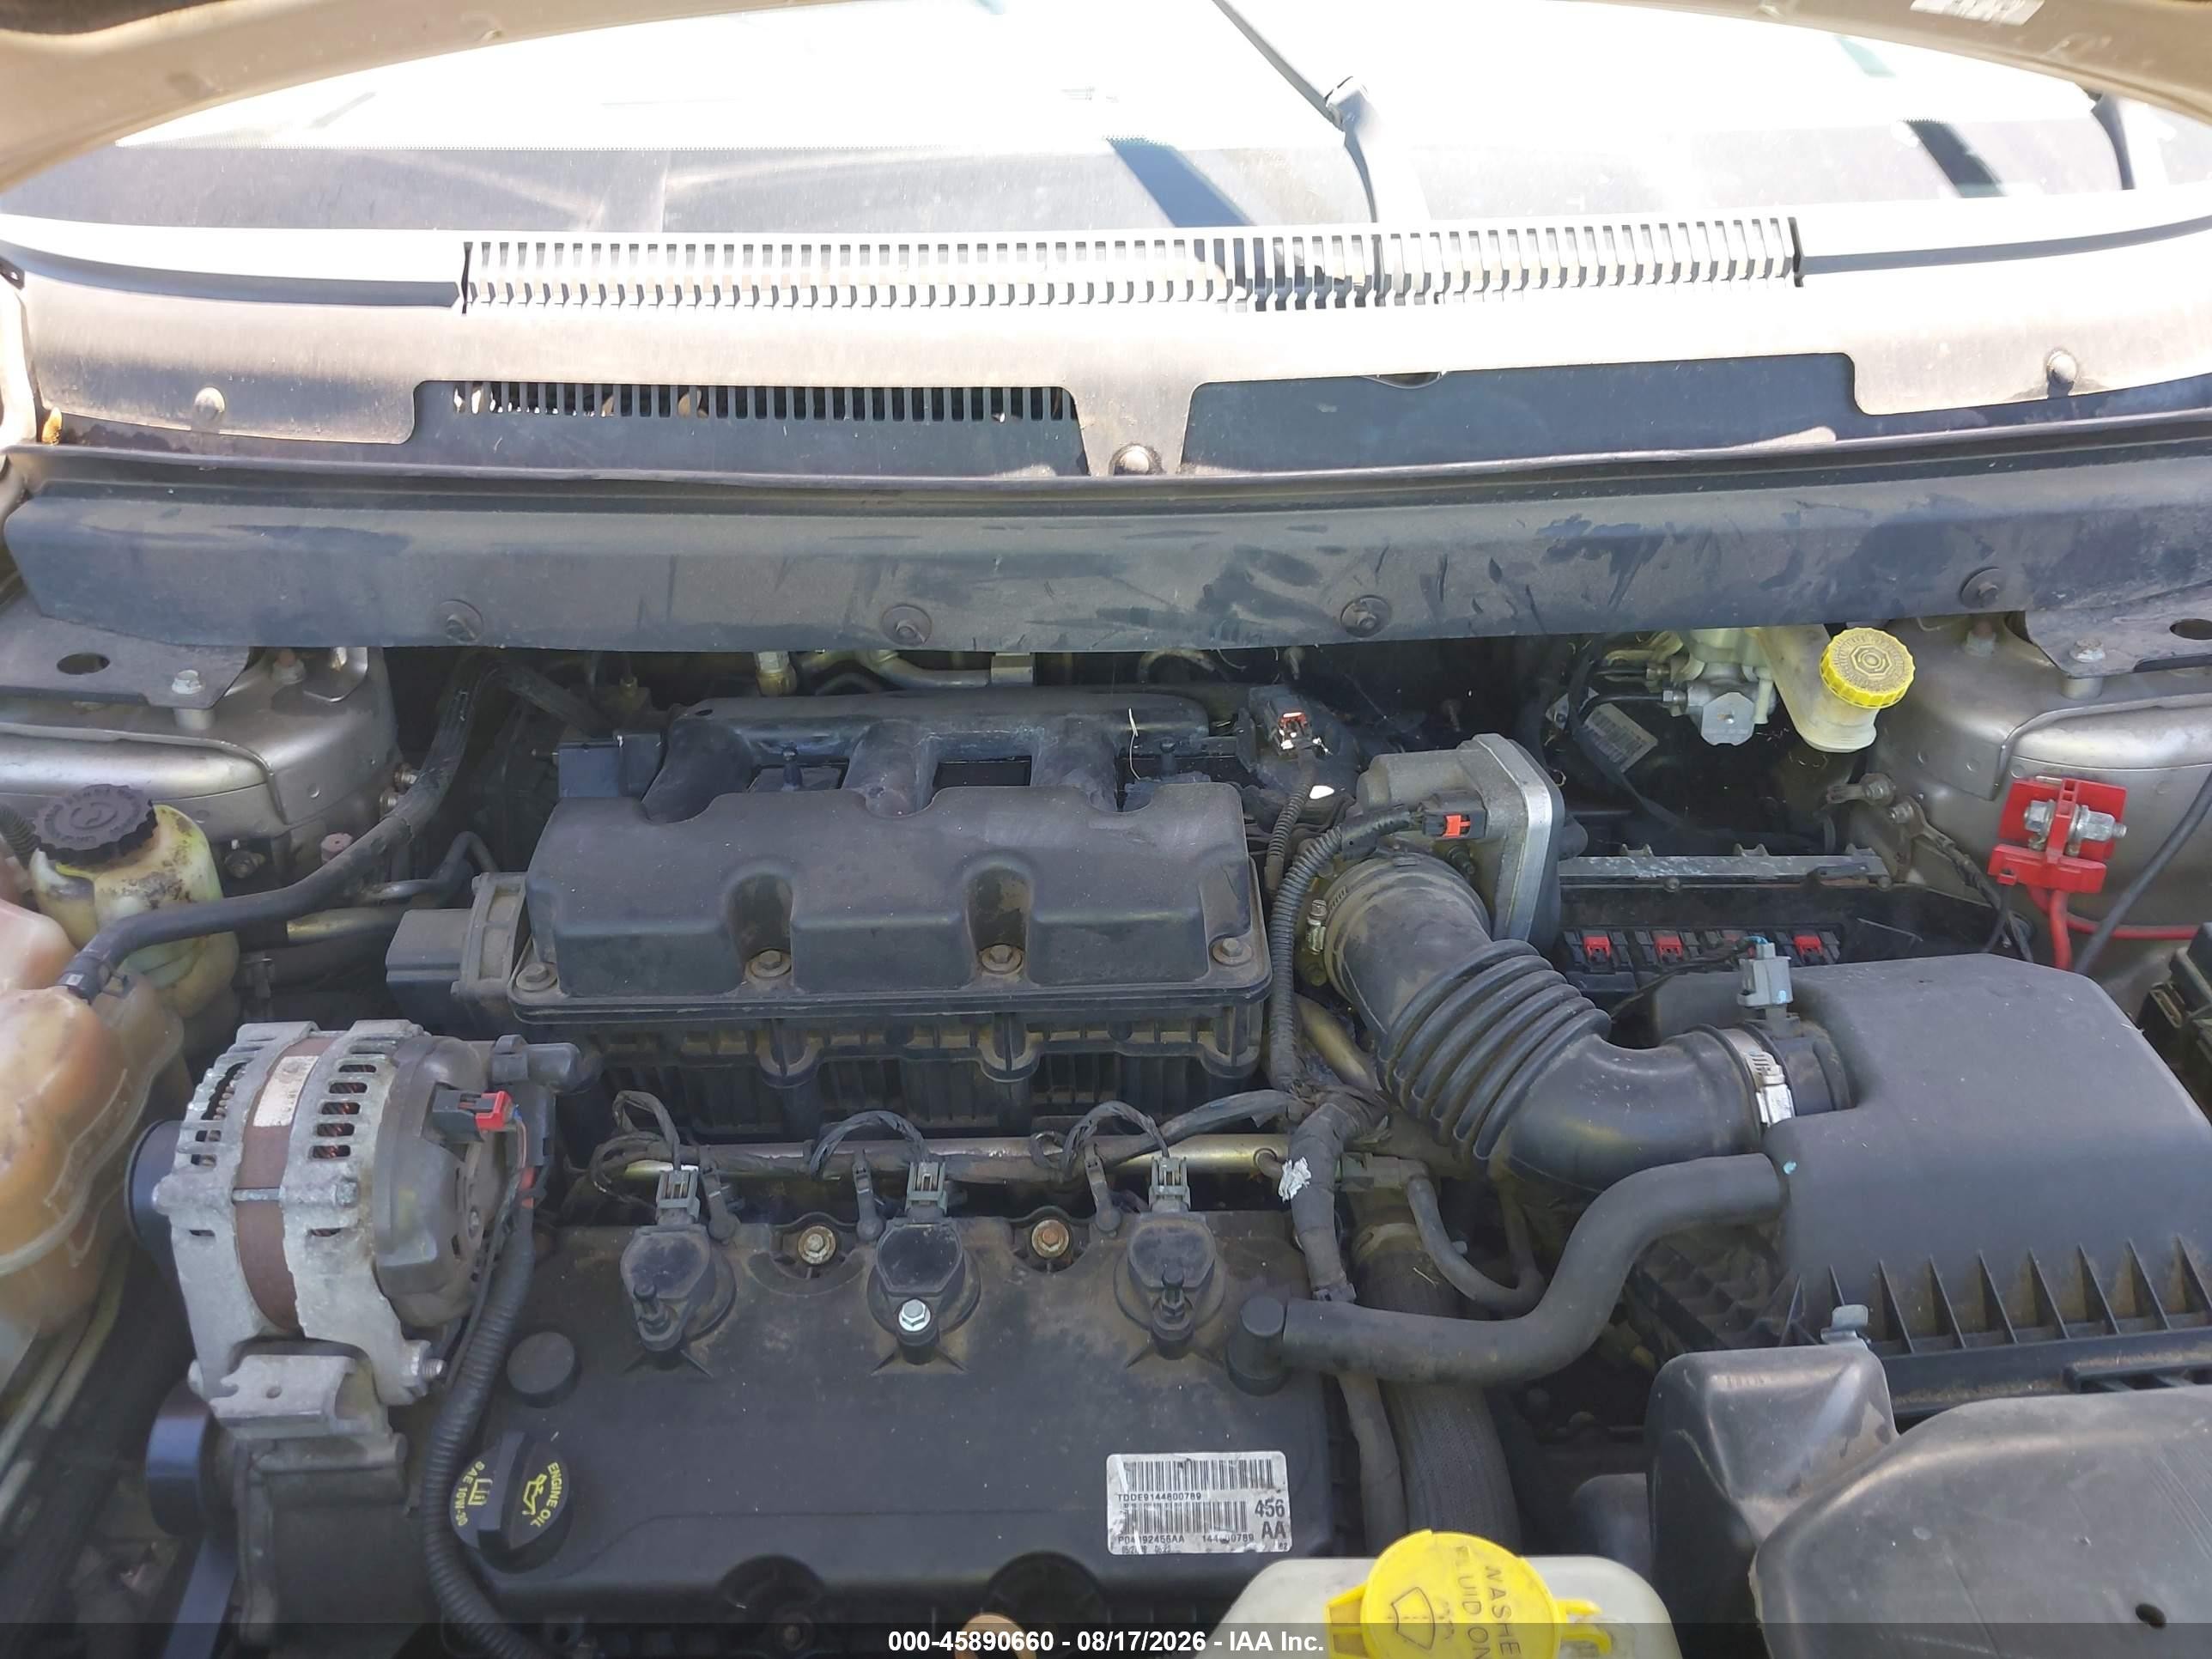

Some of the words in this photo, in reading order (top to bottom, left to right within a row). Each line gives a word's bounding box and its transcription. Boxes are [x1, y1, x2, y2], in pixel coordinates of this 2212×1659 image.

[547, 1462, 562, 1509] ENGINE
[1255, 1498, 1285, 1517] 456
[530, 1509, 551, 1528] OIL
[1261, 1521, 1286, 1540] AA
